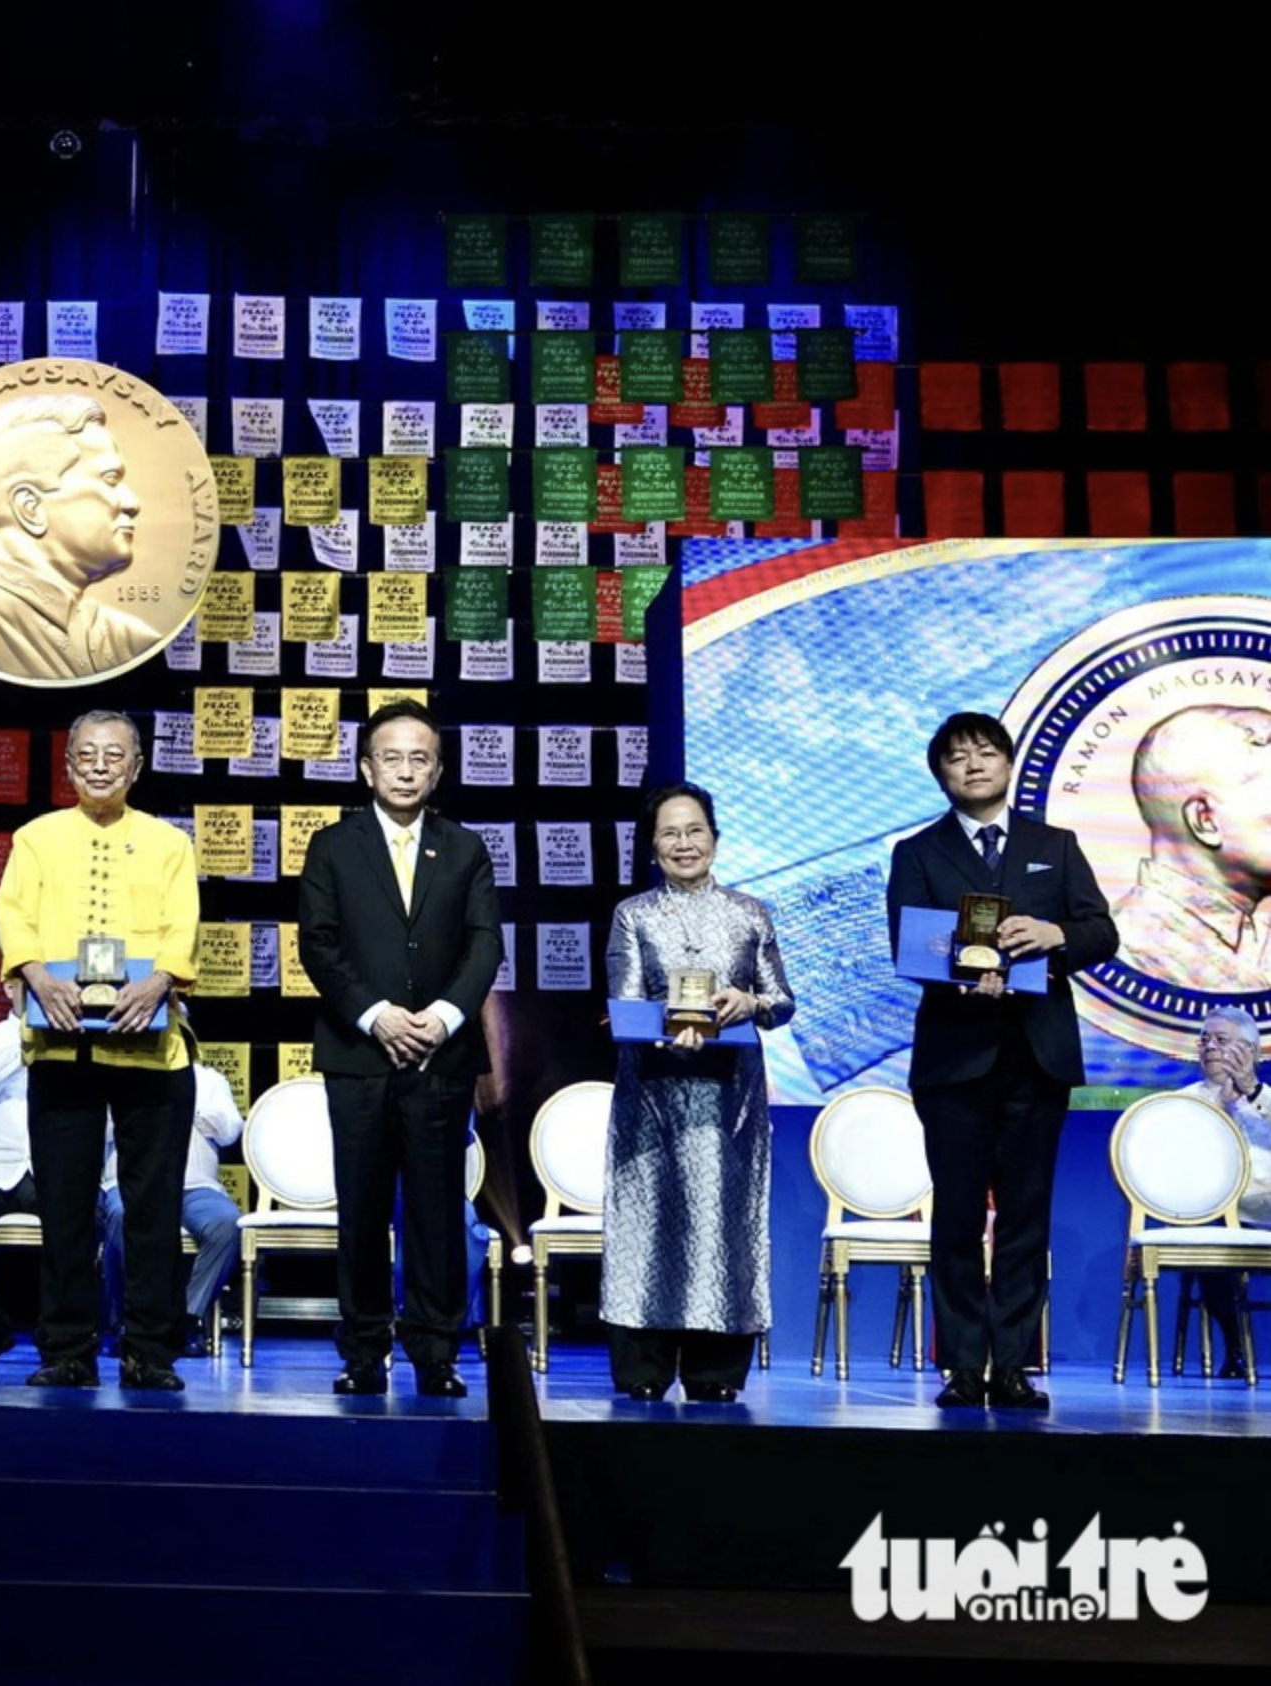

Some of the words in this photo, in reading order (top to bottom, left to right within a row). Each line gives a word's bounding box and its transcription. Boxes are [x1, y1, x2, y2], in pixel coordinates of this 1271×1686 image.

[455, 231, 493, 240] PEACE
[541, 231, 579, 239] PEACE
[241, 308, 275, 316] PEACE
[317, 310, 351, 318] PEACE
[471, 312, 505, 320] PEACE
[543, 347, 581, 356] PEACE
[630, 346, 668, 354] PEACE
[719, 345, 759, 354] PEACE
[597, 370, 621, 378] PEA
[457, 465, 495, 473] PEACE
[545, 463, 583, 472] PEACE
[633, 463, 671, 471] PEACE
[721, 463, 759, 471] PEACE
[291, 471, 329, 479] PEACE
[377, 470, 415, 478] PEACE
[597, 478, 622, 486] PEA
[181, 467, 216, 598] AWARD
[543, 525, 577, 533] PEACE
[456, 582, 494, 590] PEACE
[544, 582, 584, 591] PEACE
[633, 580, 663, 589] PEAC
[205, 586, 243, 594] PEACE
[290, 587, 328, 595] PEACE
[377, 586, 415, 594] PEACE
[203, 701, 241, 710] PEACE
[291, 704, 329, 712] PEACE
[547, 736, 581, 744] PEACE
[625, 737, 648, 745] PEA
[1062, 704, 1129, 794] RAMON
[204, 820, 242, 828] PEACE
[485, 835, 505, 843] ACE
[546, 835, 580, 843] PEACE
[202, 940, 240, 948] PEACE
[546, 939, 580, 947] PEACE
[202, 1059, 240, 1068] PEACE
